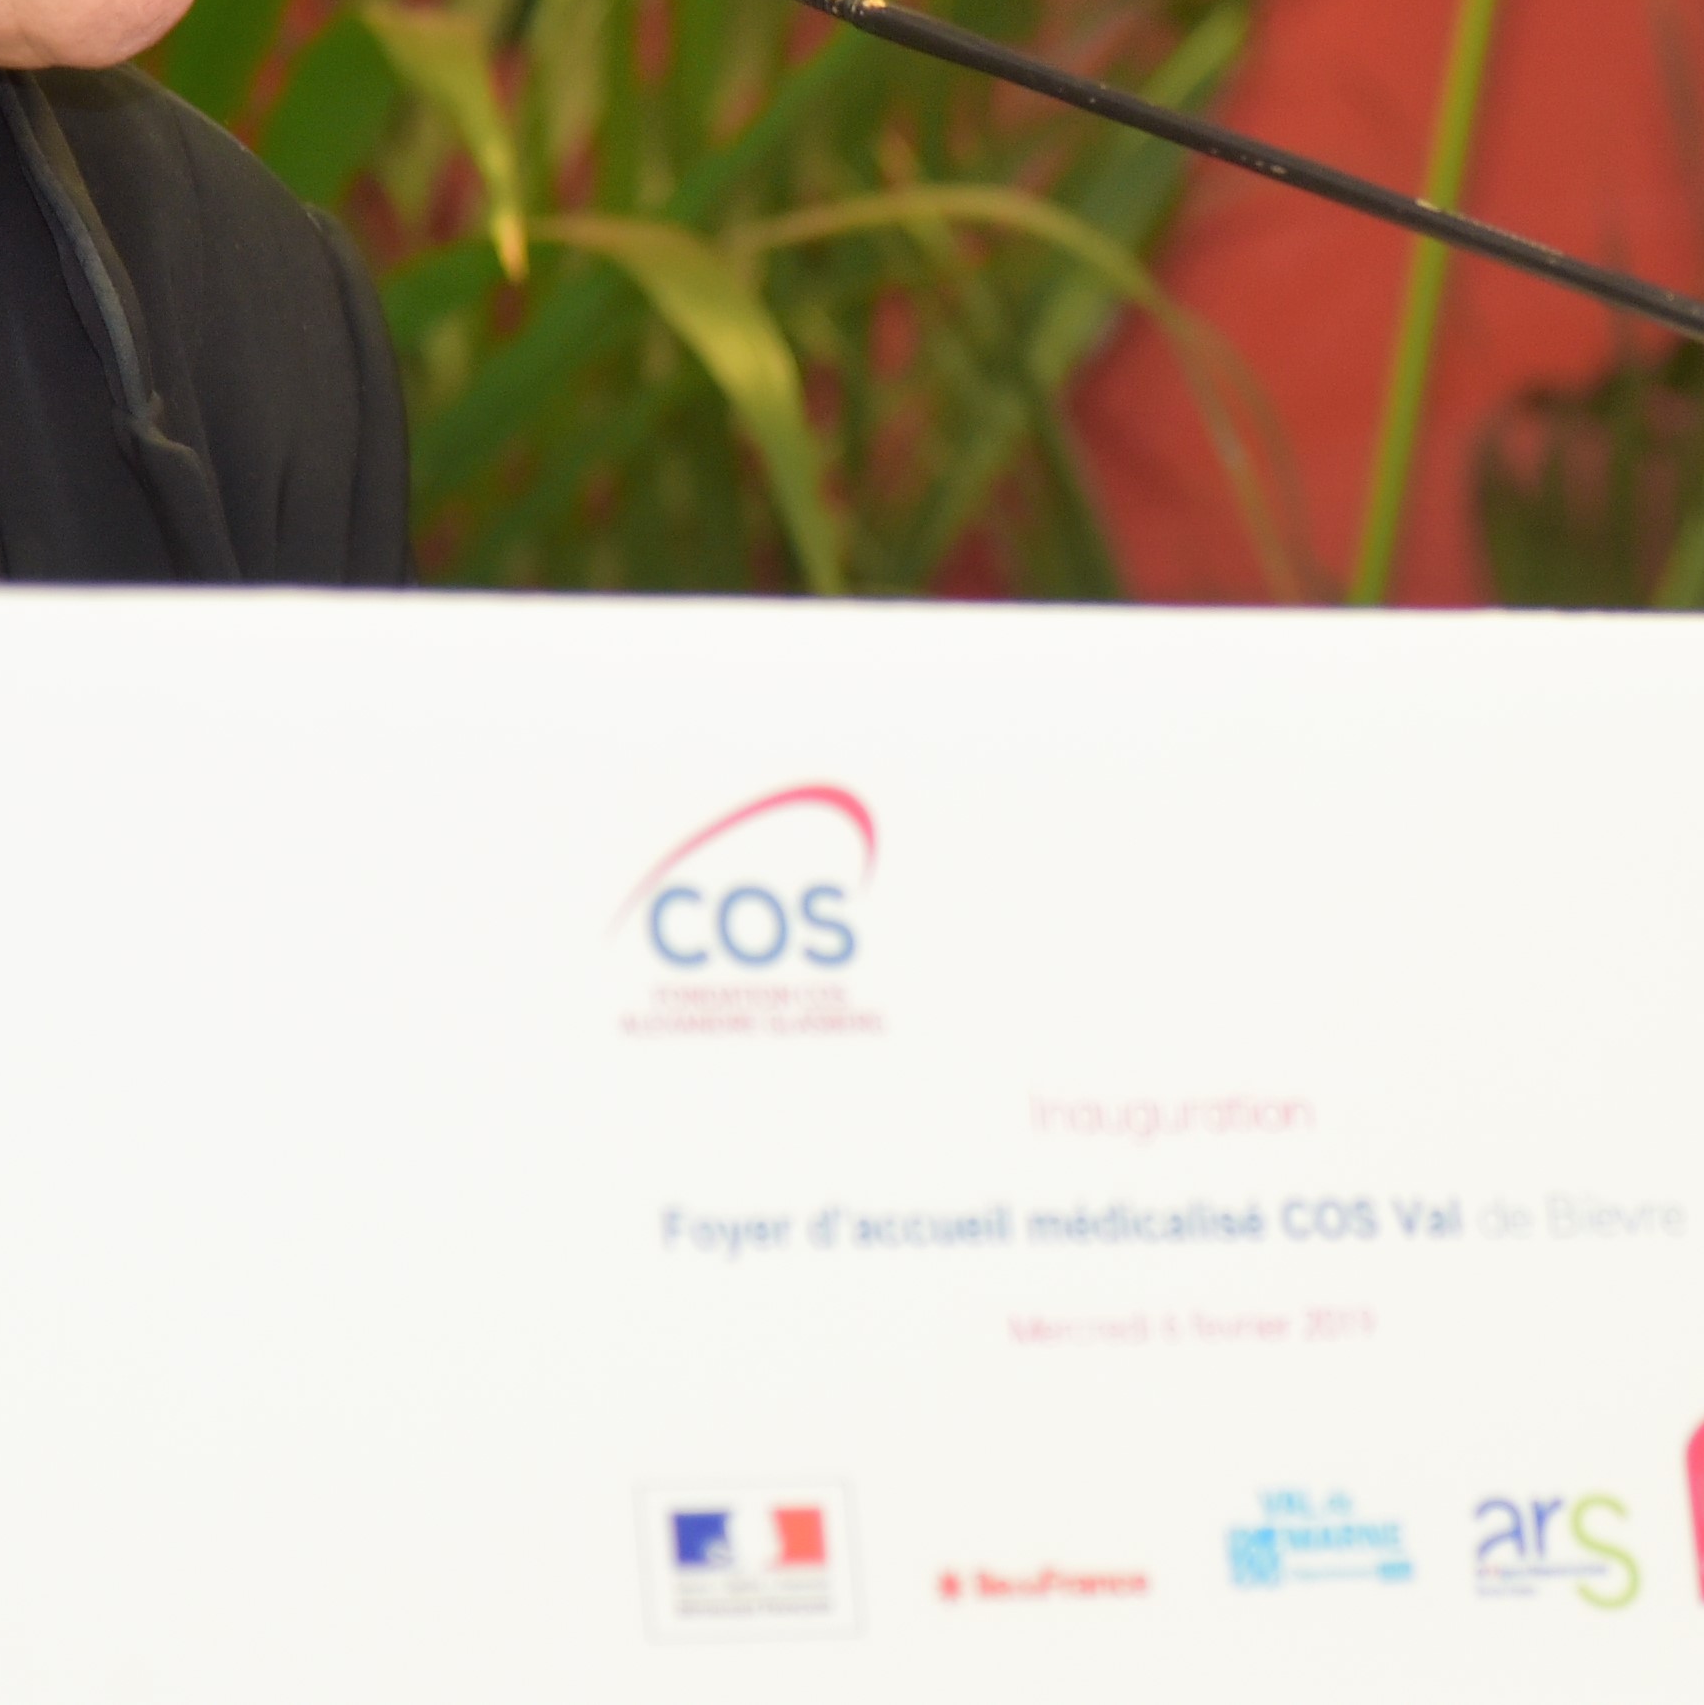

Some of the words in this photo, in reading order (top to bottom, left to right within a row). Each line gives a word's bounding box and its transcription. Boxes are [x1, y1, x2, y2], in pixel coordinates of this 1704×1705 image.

[647, 883, 857, 968] COS
[1030, 1093, 1316, 1144] Inauguration
[659, 1205, 791, 1261] Foyer
[806, 1203, 1014, 1250] d'accueil
[1026, 1199, 1267, 1244] médicalisé
[1280, 1196, 1379, 1241] COS
[1392, 1198, 1464, 1241] Val
[1475, 1192, 1536, 1242] de
